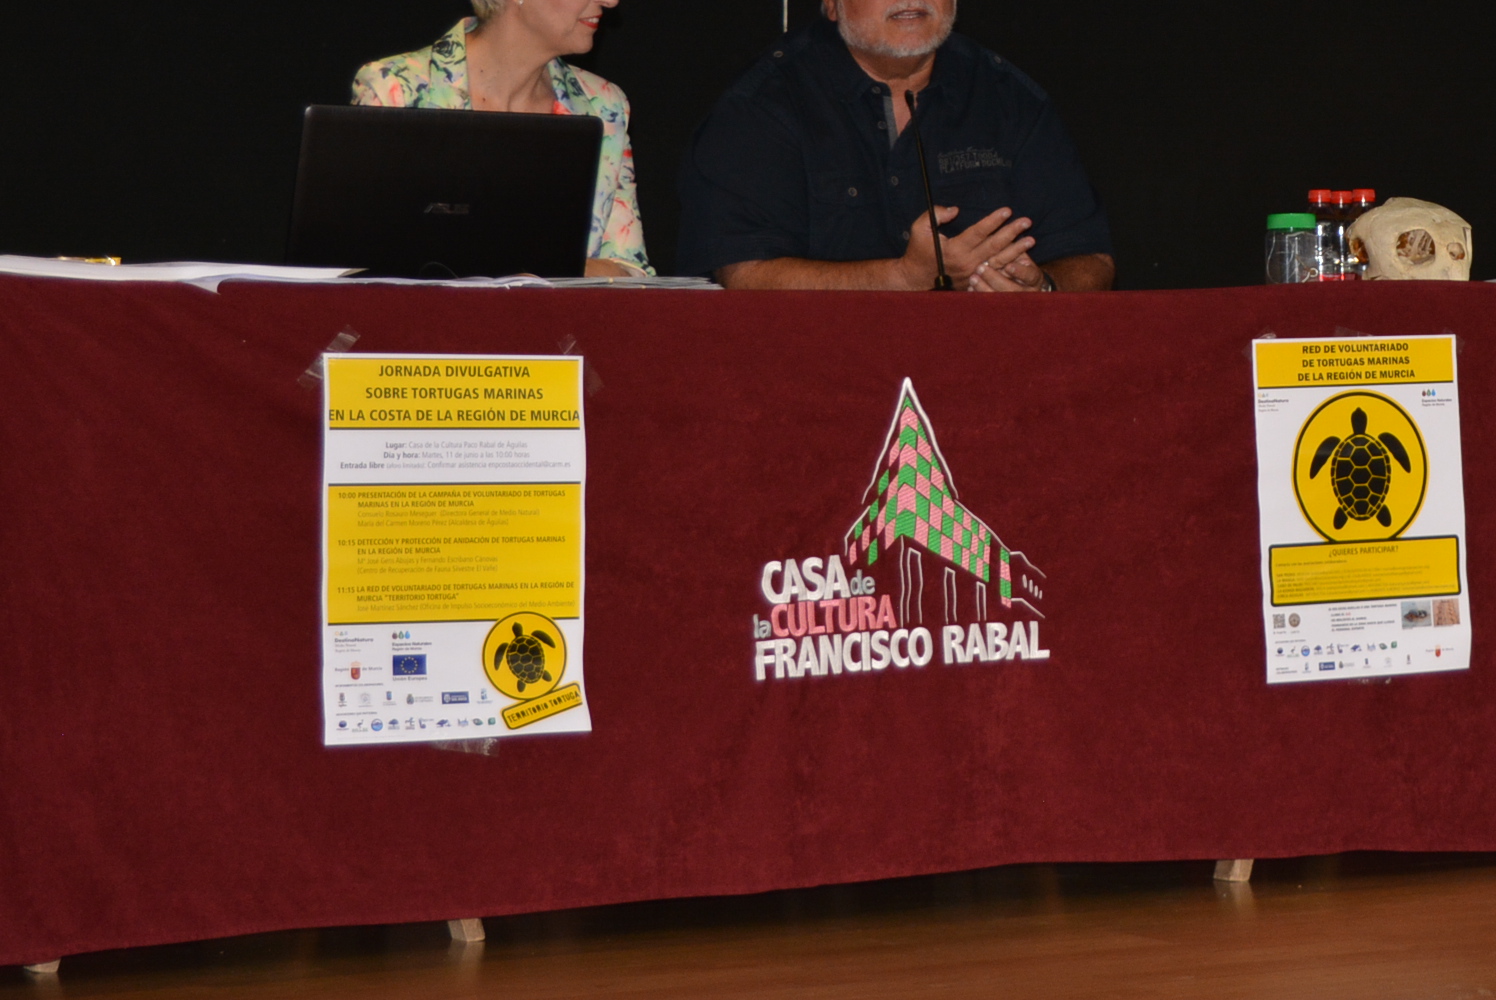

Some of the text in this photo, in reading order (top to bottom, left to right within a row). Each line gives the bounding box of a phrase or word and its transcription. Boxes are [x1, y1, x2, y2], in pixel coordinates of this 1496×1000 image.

[1302, 343, 1409, 354] RED DE VOLUNTARIADO
[1302, 357, 1410, 367] DE TORTUGAS MARINAS
[379, 365, 530, 378] JORNADA DIVULGATIVA
[1298, 369, 1415, 381] DE LA REGIÓN DE MURCIA
[365, 388, 543, 399] SOBRE TORTUGAS MARINAS
[329, 407, 580, 421] EN LA COSTA DE LA REGIÓN DE MURCIA
[358, 490, 407, 499] PRESENTACIÓN
[428, 490, 461, 498] CAMPAÑA
[411, 499, 436, 507] REGIÓN
[357, 537, 394, 546] DETECCIÓN
[401, 536, 442, 545] PROTECCIÓN
[453, 535, 490, 544] ANIDACIÓN
[378, 546, 403, 554] REGIÓN
[1329, 545, 1398, 557] ¿QUIERES PARTICIPAR?
[761, 555, 876, 604] CASA de
[391, 584, 441, 592] VOLUNTARIADO
[453, 583, 486, 591] TORTUGAS
[540, 580, 564, 589] REGIÓN
[357, 594, 383, 602] MURCIA
[384, 593, 425, 601] "TERRITORIO
[753, 594, 897, 639] la CULTURA
[754, 621, 1050, 681] FRANCISCO RABAL
[507, 691, 580, 723] TERRITORIO TORTUGA
